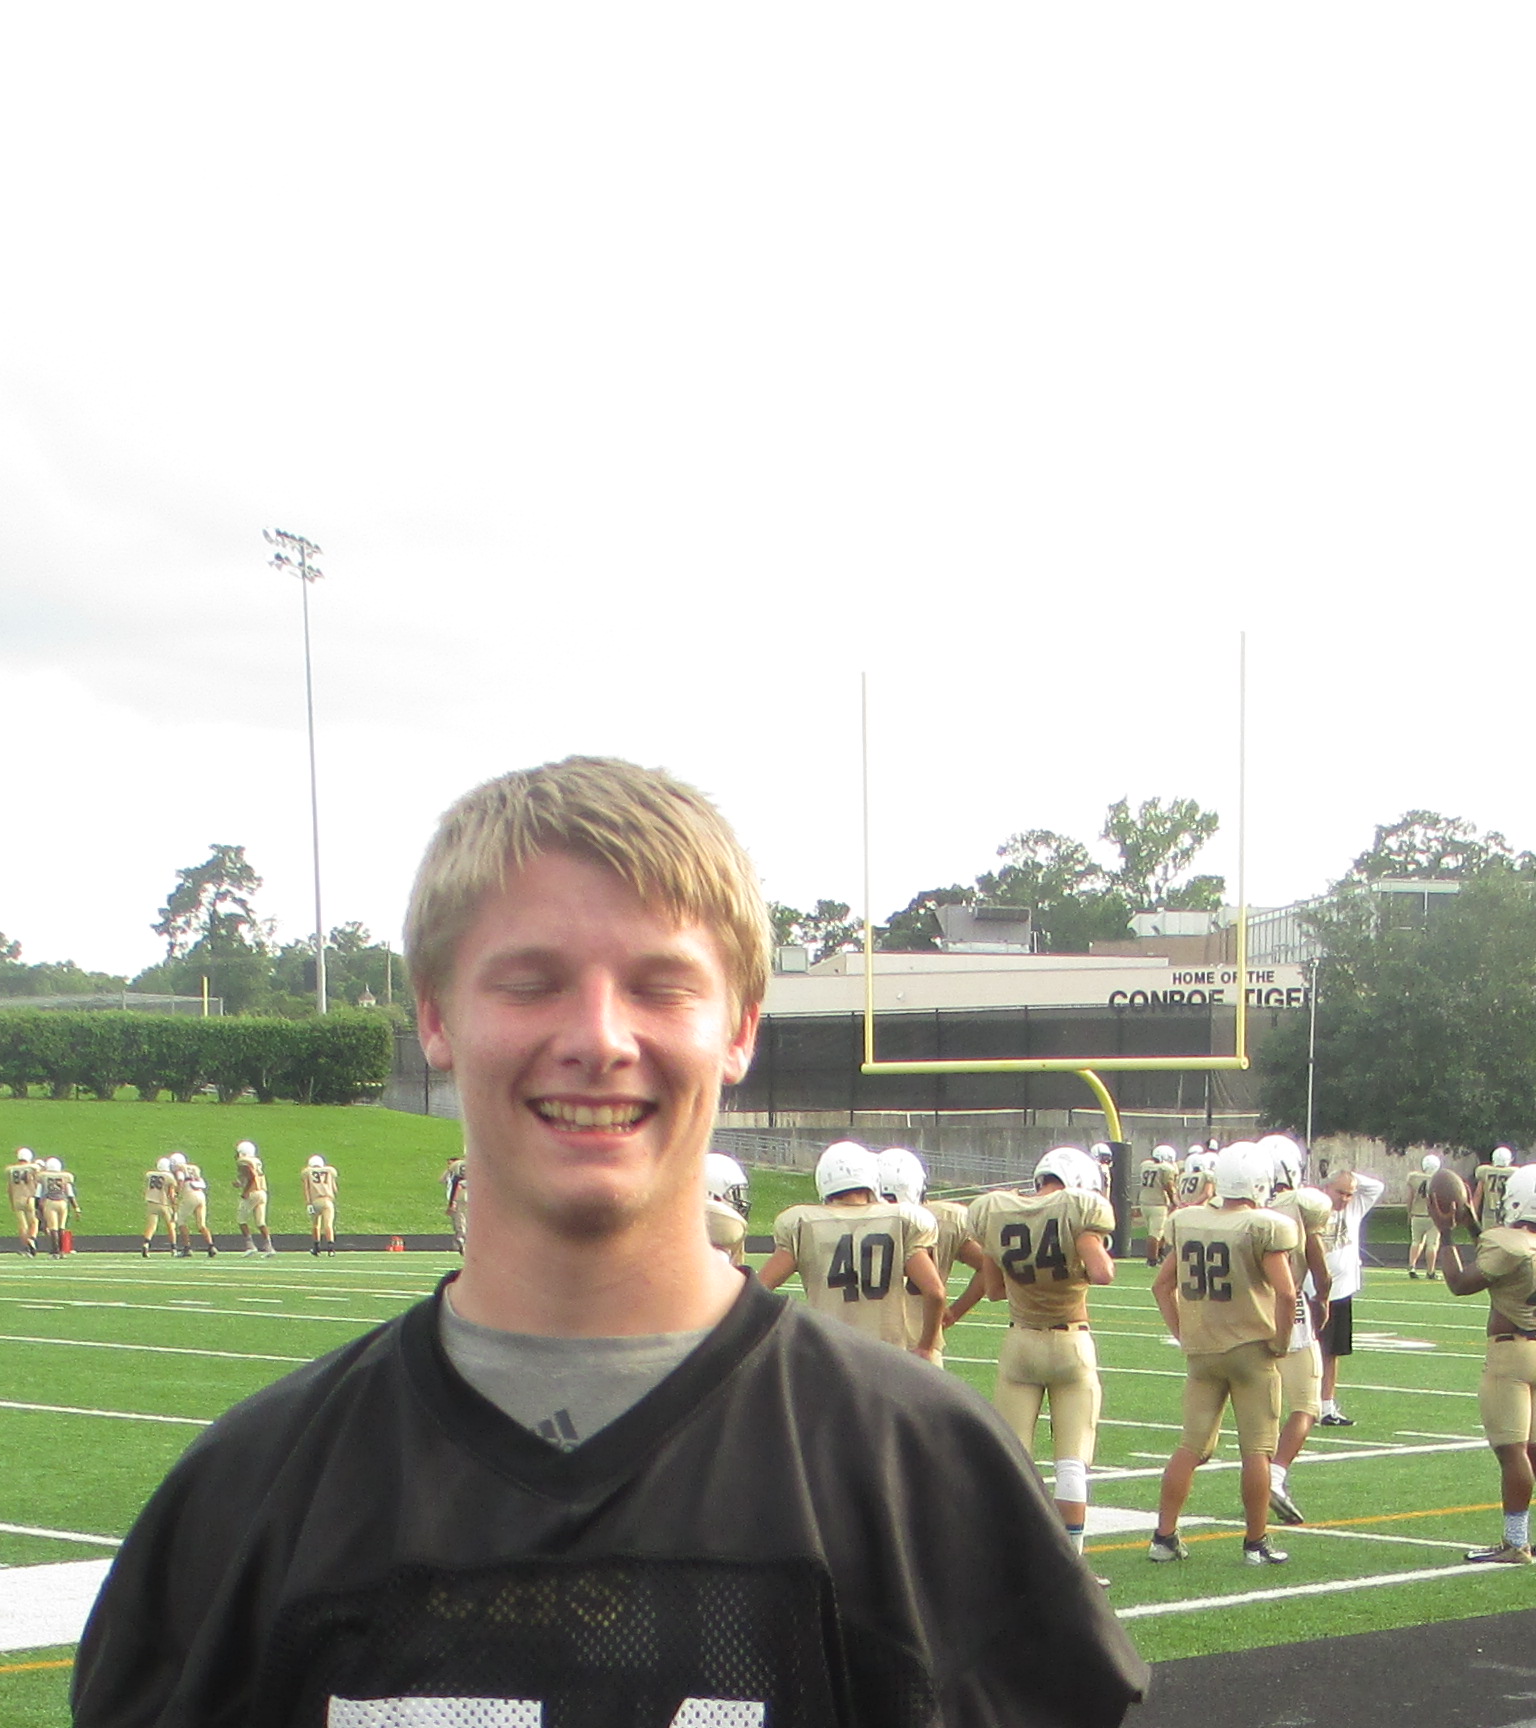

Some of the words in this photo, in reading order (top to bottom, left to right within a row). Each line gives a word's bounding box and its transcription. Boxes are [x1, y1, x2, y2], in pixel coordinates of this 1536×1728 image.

[1173, 972, 1214, 985] HOME
[1246, 971, 1275, 984] THE
[1109, 989, 1224, 1011] CONROE
[312, 1171, 328, 1184] 37
[1143, 1171, 1157, 1187] 97
[1181, 1177, 1199, 1194] 79
[1001, 1218, 1069, 1285] 24
[827, 1233, 895, 1302] 40
[1181, 1240, 1232, 1301] 32
